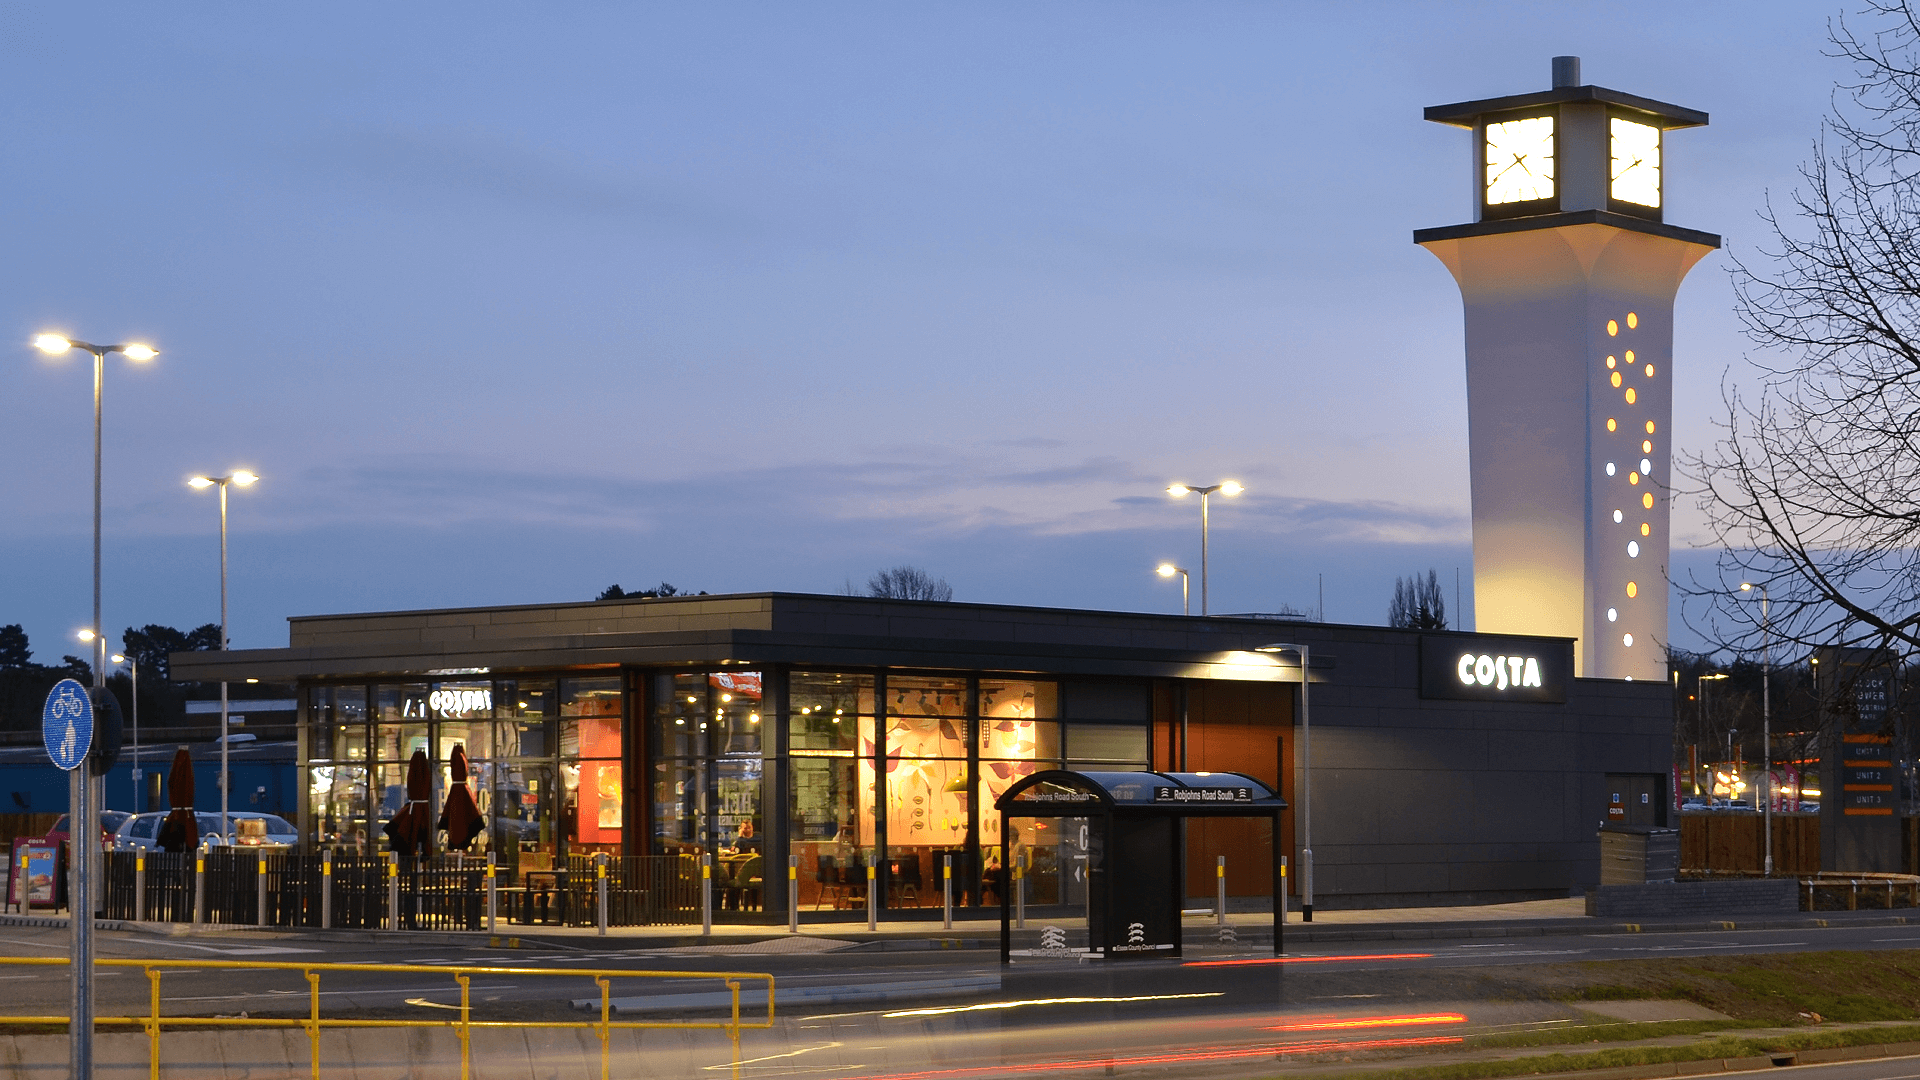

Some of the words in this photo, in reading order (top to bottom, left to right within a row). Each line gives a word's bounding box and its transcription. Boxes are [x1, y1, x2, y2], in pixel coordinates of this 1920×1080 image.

[1458, 653, 1542, 691] COSTA
[1853, 679, 1884, 688] LOCK
[1855, 691, 1885, 700] OWER
[1856, 771, 1874, 780] UNIT
[1876, 771, 1881, 780] 2
[1054, 792, 1070, 801] Road
[1071, 792, 1090, 801] South
[1174, 789, 1201, 803] Robjohns
[1201, 790, 1217, 801] Road
[1217, 790, 1235, 801] South
[1856, 795, 1874, 804] UNIT
[1876, 795, 1881, 804] 3
[1128, 944, 1141, 952] County
[1142, 943, 1156, 951] Council
